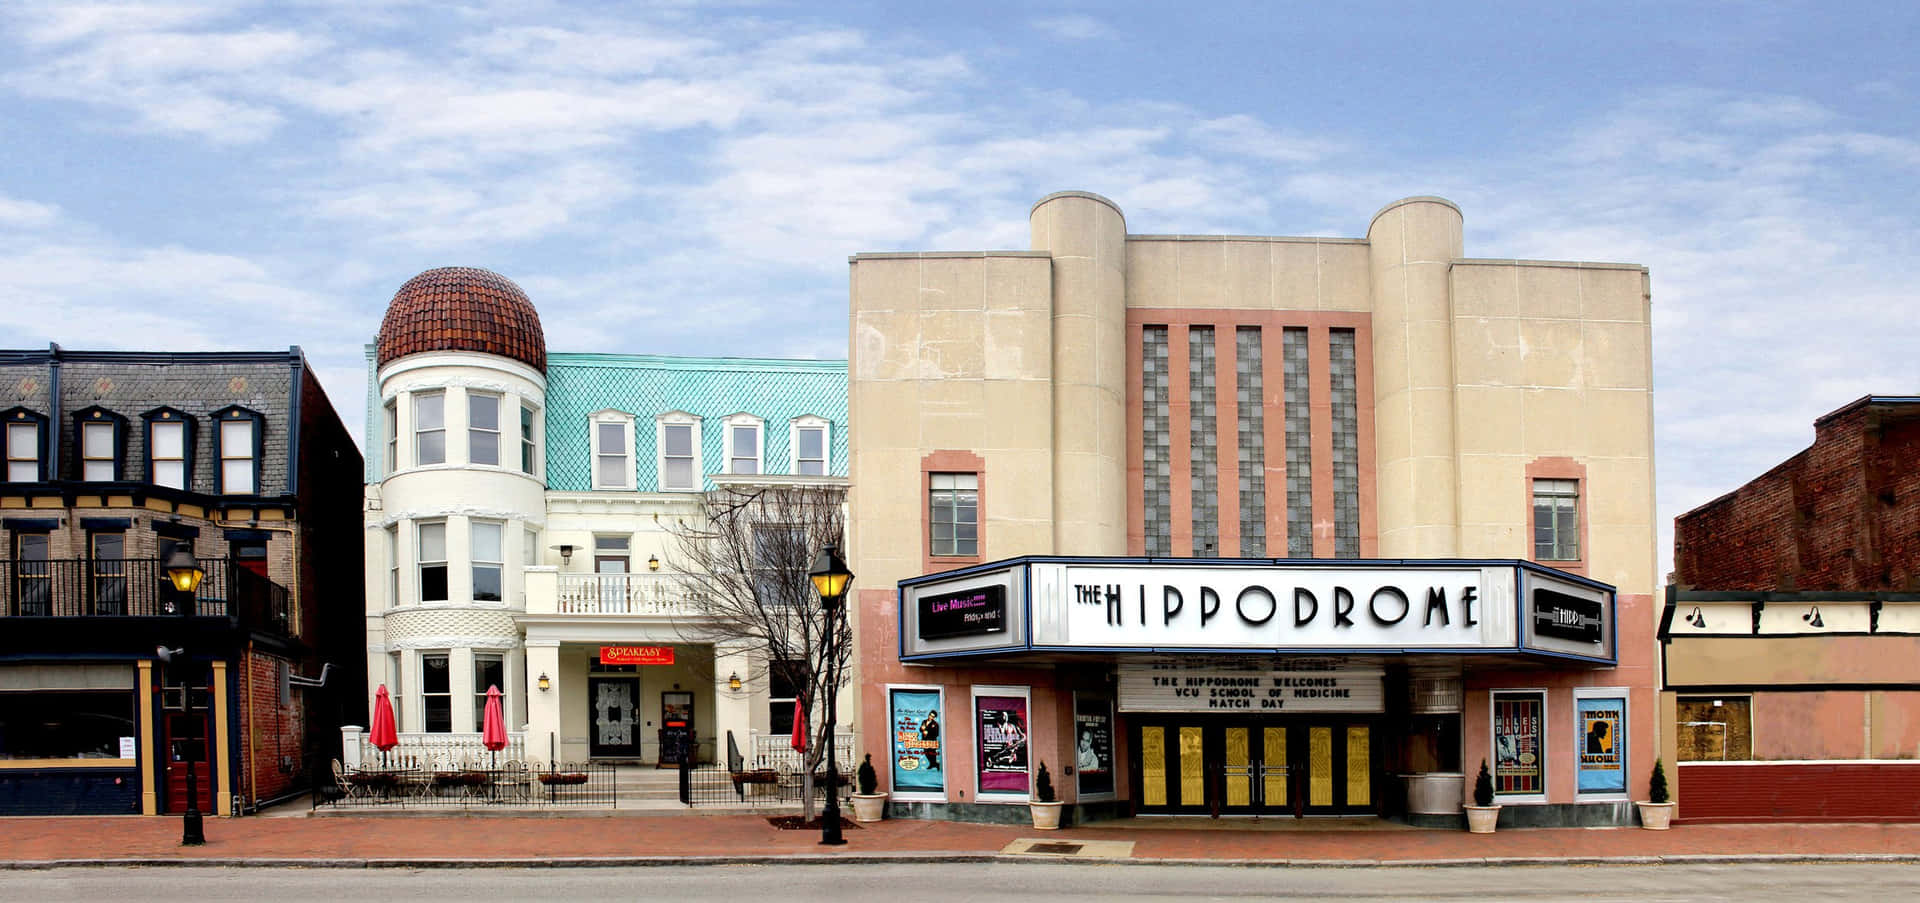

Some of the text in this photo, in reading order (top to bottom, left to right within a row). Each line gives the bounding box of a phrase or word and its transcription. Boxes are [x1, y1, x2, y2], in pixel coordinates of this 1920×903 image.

[932, 602, 948, 613] Live
[1074, 584, 1479, 627] THE HIPPODROME
[1560, 608, 1579, 625] HIPP
[607, 647, 660, 659] SPEAKEASY
[1152, 677, 1337, 687] THE HIPPODROME WELCOMES
[1175, 688, 1350, 698] VCU SCHOOL OF MEDICINE
[1209, 699, 1284, 708] MATCH DAY
[1584, 710, 1619, 720] MONK
[1495, 716, 1537, 726] MILES
[1495, 725, 1537, 735] DAVIS
